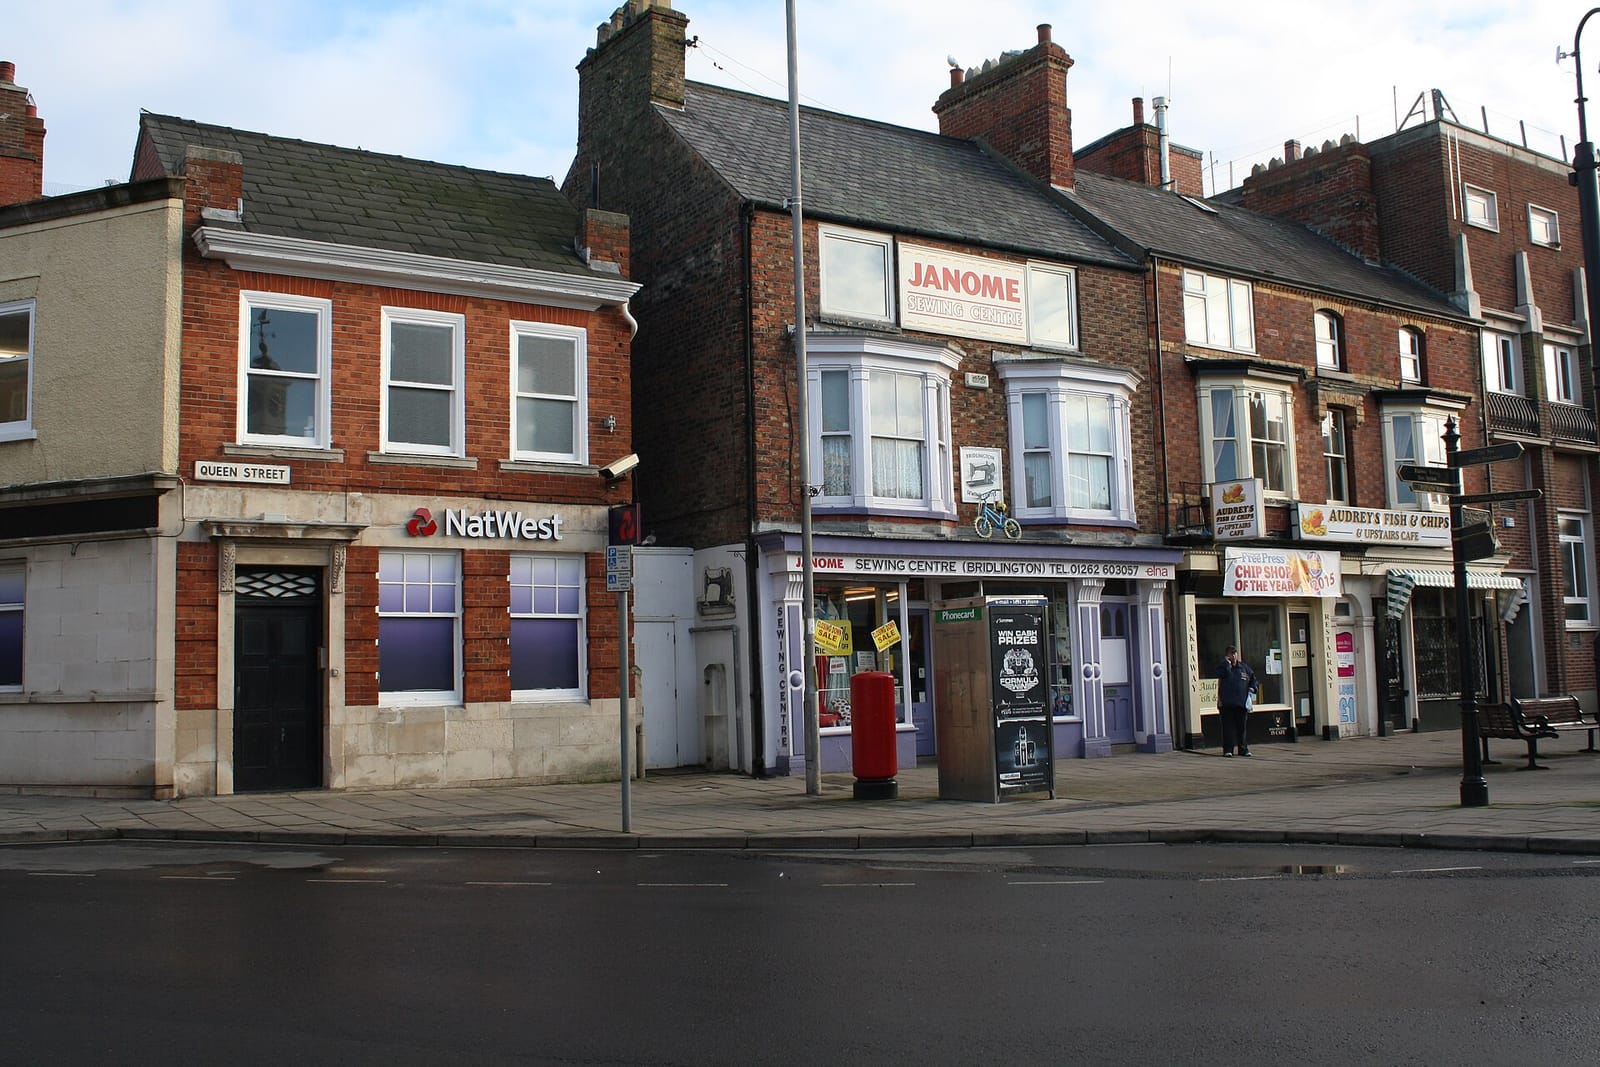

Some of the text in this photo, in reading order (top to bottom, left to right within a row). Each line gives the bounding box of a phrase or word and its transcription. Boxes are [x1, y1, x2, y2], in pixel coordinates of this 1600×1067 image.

[908, 262, 1020, 303] JANOME
[907, 295, 1023, 327] SEWING CENTRE
[200, 465, 286, 480] QUEEN STREET
[445, 509, 563, 541] NatWest
[1329, 509, 1450, 528] AUDREY'S FISH & CHIPS
[1224, 522, 1251, 530] UPSTAIRS
[1356, 528, 1419, 541] & UPSTAIRS CAFE
[1242, 552, 1285, 564] Free Press
[796, 557, 1168, 576] JNOME SEWING CENTRE (BRIDLINGTON) TEL.01262 603057 elna
[1234, 565, 1292, 578] CHIP SHOP
[1234, 580, 1296, 592] OF THE YEAR
[1311, 572, 1335, 591] 2015
[942, 608, 975, 620] Phonecard
[818, 630, 838, 642] SALE
[878, 630, 896, 643] SALE
[998, 636, 1038, 645] PRIZES
[1188, 614, 1197, 692] TAKEAWAY
[1324, 614, 1334, 688] RESTAURANT
[776, 607, 788, 746] SEWING CENTRE
[1000, 676, 1039, 686] FORMULA
